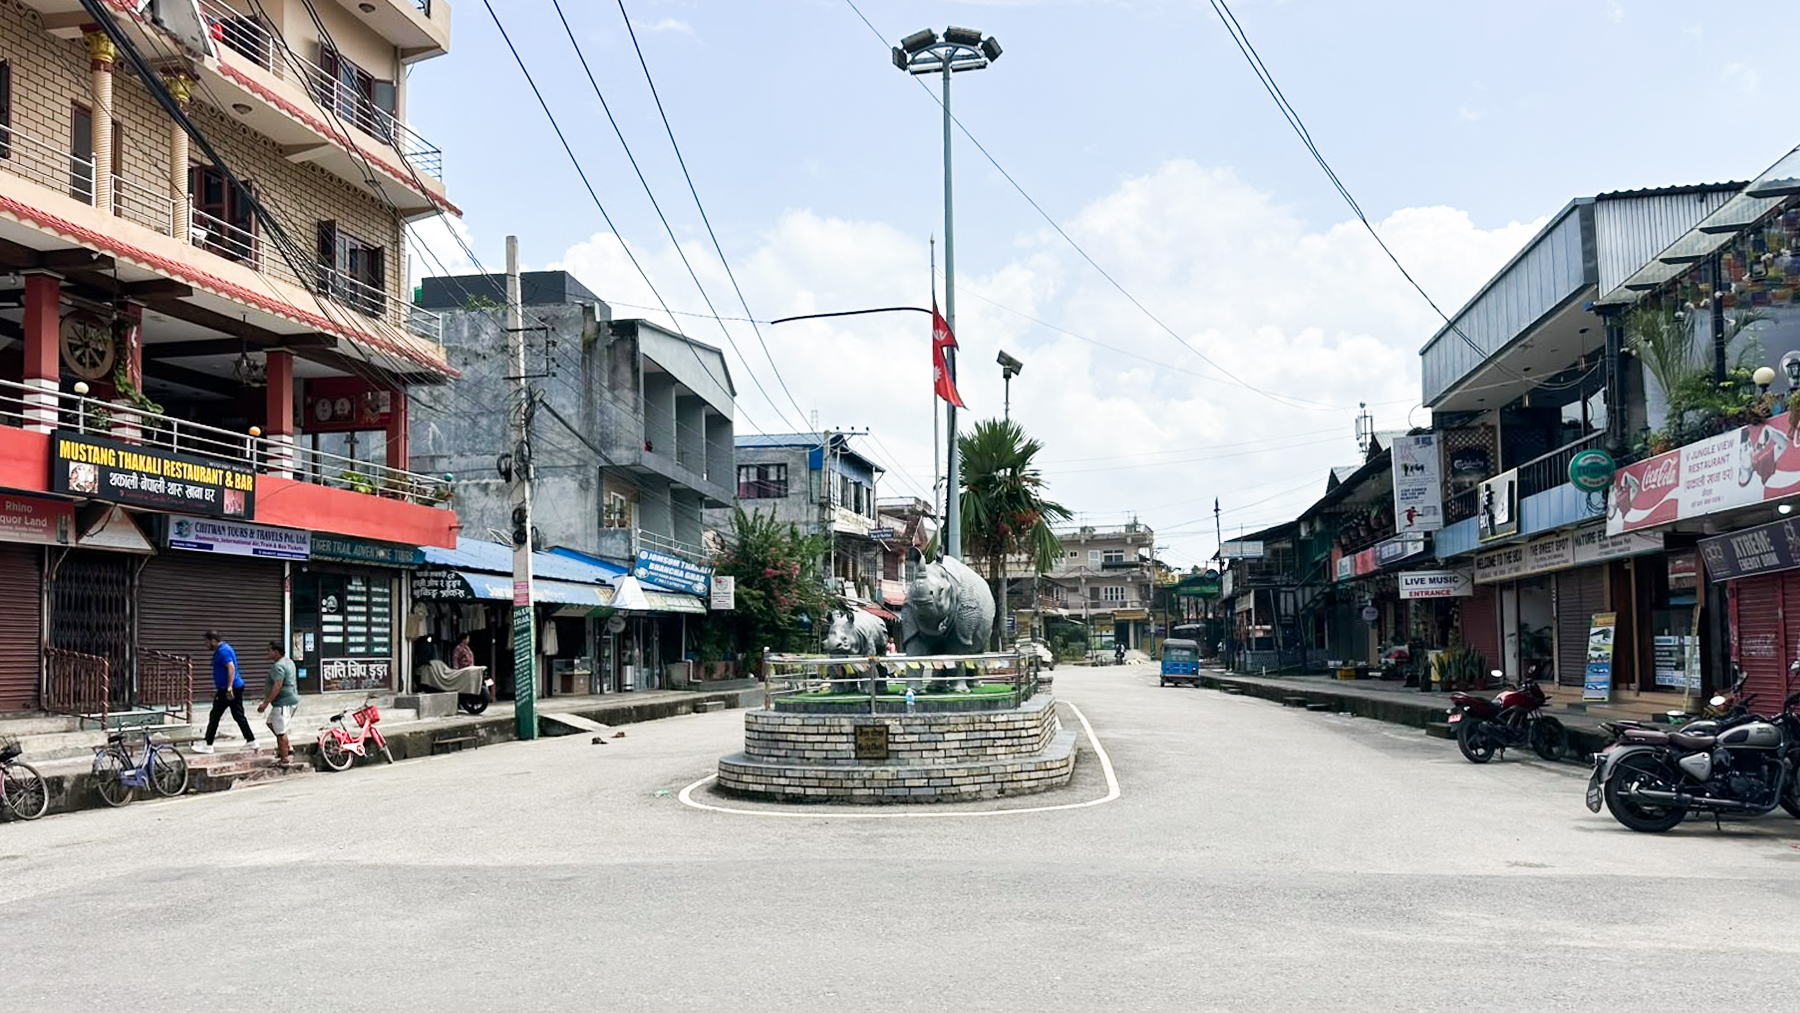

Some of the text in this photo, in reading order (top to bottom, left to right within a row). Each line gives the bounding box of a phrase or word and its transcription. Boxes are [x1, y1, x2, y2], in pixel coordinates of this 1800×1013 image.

[1691, 445, 1716, 460] JUNGLE
[1716, 438, 1735, 454] VIEW
[59, 439, 116, 467] MUSTANG
[118, 450, 162, 474] THAKALI
[163, 459, 224, 486] RESTAURANT
[225, 473, 234, 488] &
[234, 474, 253, 492] BAR
[1454, 459, 1484, 470] Carlsberg
[1688, 453, 1731, 473] RESTAURANT
[1641, 456, 1679, 493] Coca-Cola
[204, 488, 216, 503] घर
[5, 501, 33, 514] Rhino
[24, 515, 48, 527] Land
[194, 521, 226, 536] CHITWAN
[228, 526, 248, 539] TOURS
[249, 529, 255, 538] &
[256, 530, 283, 542] TRAVELS
[296, 534, 307, 545] Ltd.
[1575, 534, 1596, 549] NATURE
[311, 538, 332, 552] TIGER
[332, 541, 351, 555] TRAIL
[394, 549, 414, 562] TOURS
[1529, 538, 1570, 556] THE SWEET SPOT
[1730, 530, 1775, 559] XTREME
[648, 552, 681, 569] JOMSOM
[1476, 556, 1497, 570] WELCOME
[1498, 554, 1504, 566] TO
[1504, 552, 1513, 564] THE
[1513, 549, 1523, 564] BOX
[1738, 556, 1762, 572] ENERGY
[1760, 552, 1780, 567] DRINK
[648, 562, 706, 583] BHANCHA GHAR
[1404, 576, 1459, 588] LIVE MUSIC
[1408, 589, 1452, 597] ENTRANCE
[514, 615, 530, 627] TRAIL
[347, 660, 367, 679] जिप
